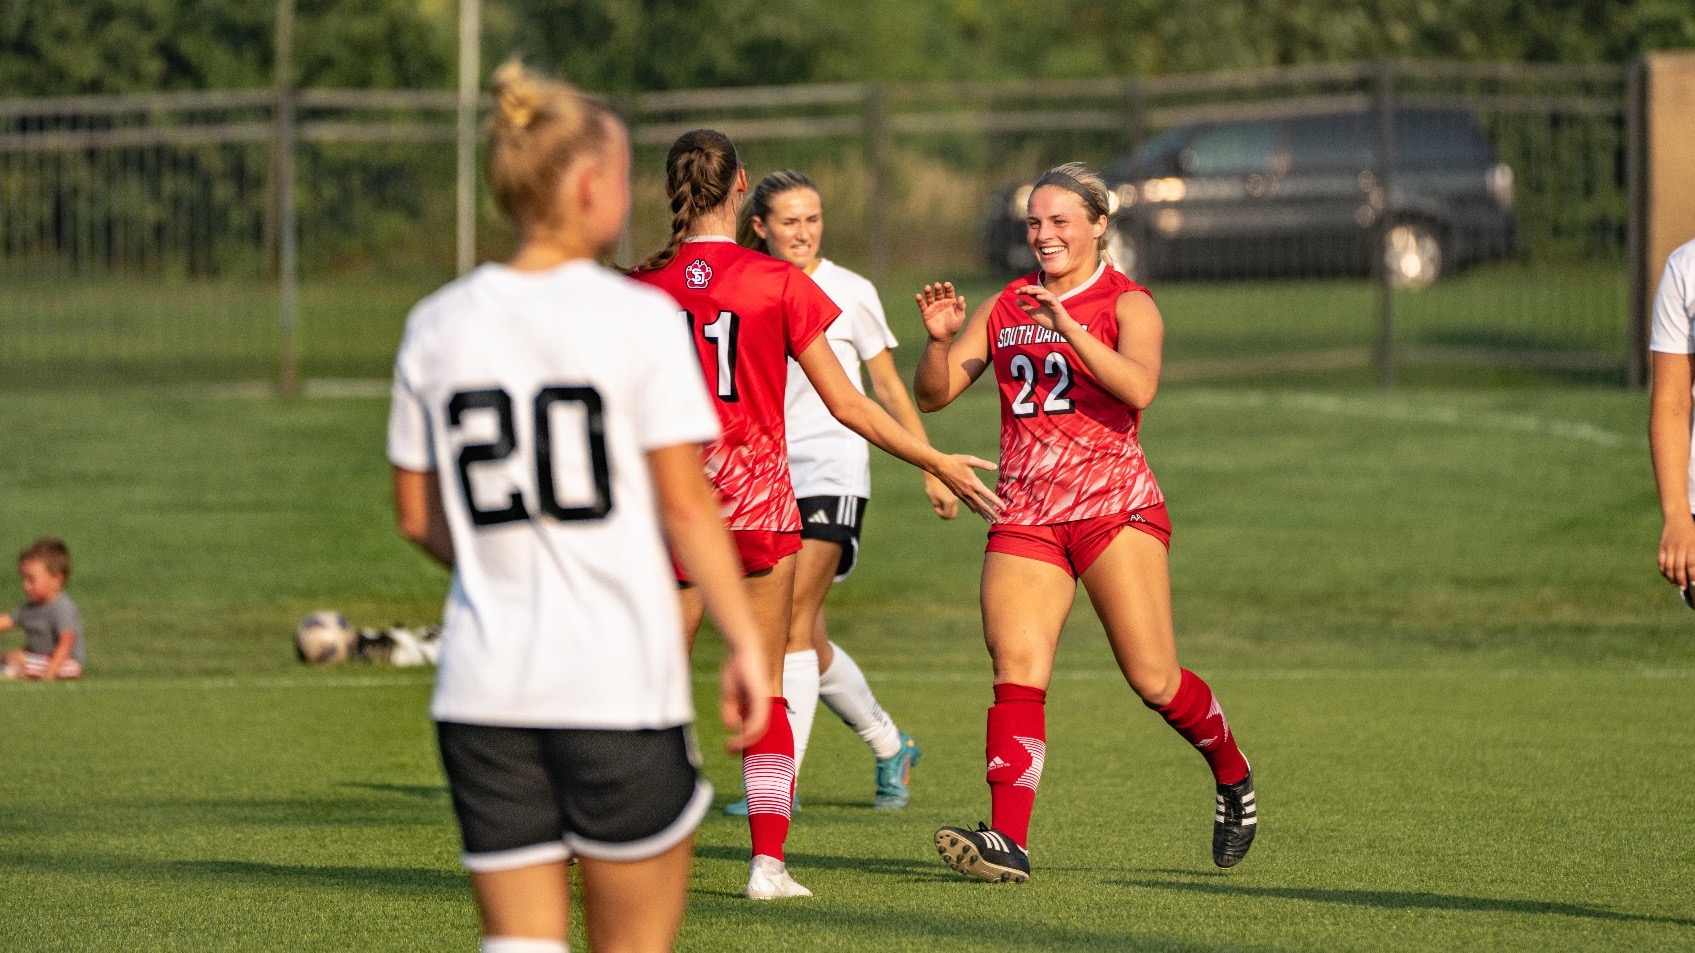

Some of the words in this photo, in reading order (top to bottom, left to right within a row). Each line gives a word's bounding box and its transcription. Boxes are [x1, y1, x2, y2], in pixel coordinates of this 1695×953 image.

[676, 309, 740, 402] 1
[997, 325, 1035, 348] SOUTH
[1010, 351, 1075, 418] 22
[449, 387, 612, 525] 20
